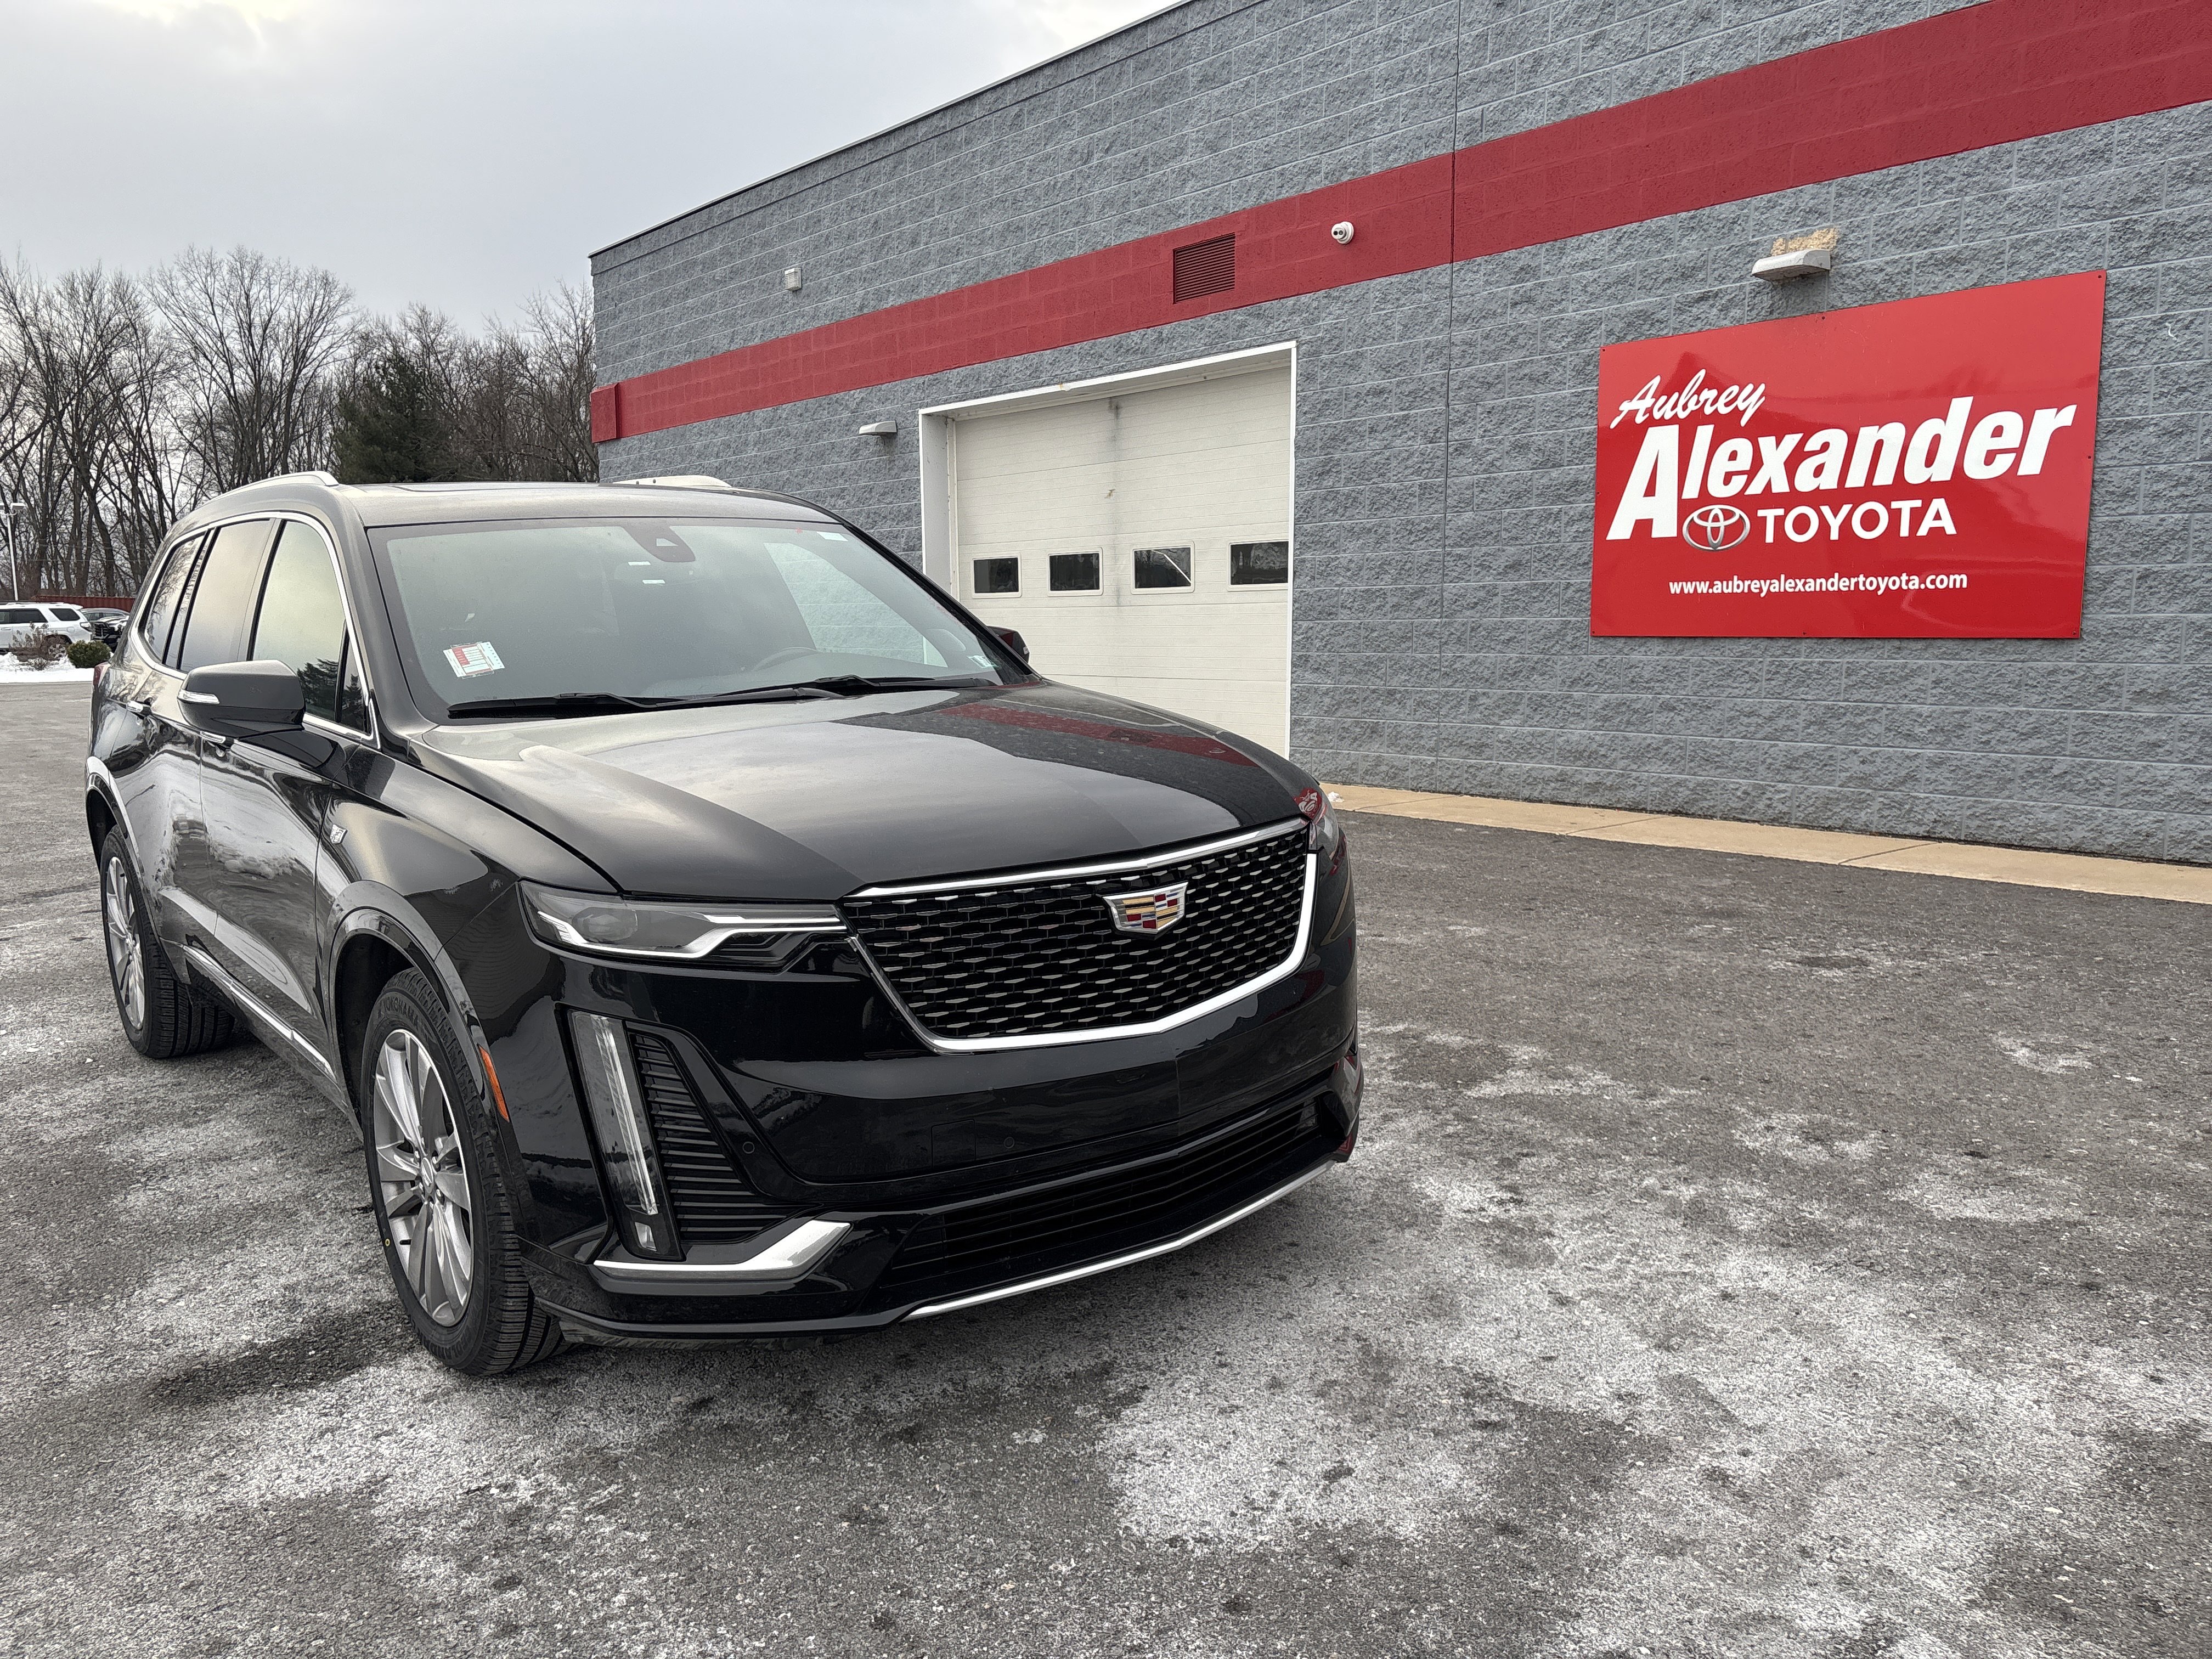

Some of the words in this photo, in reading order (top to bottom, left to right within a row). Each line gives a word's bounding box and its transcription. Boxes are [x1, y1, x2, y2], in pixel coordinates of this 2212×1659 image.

[1610, 369, 1765, 429] Aubrey
[1606, 396, 2078, 540] Alexander
[1757, 498, 1957, 543] TOYOTA
[1669, 572, 1967, 597] www.aubreyalexandertoyota.com
